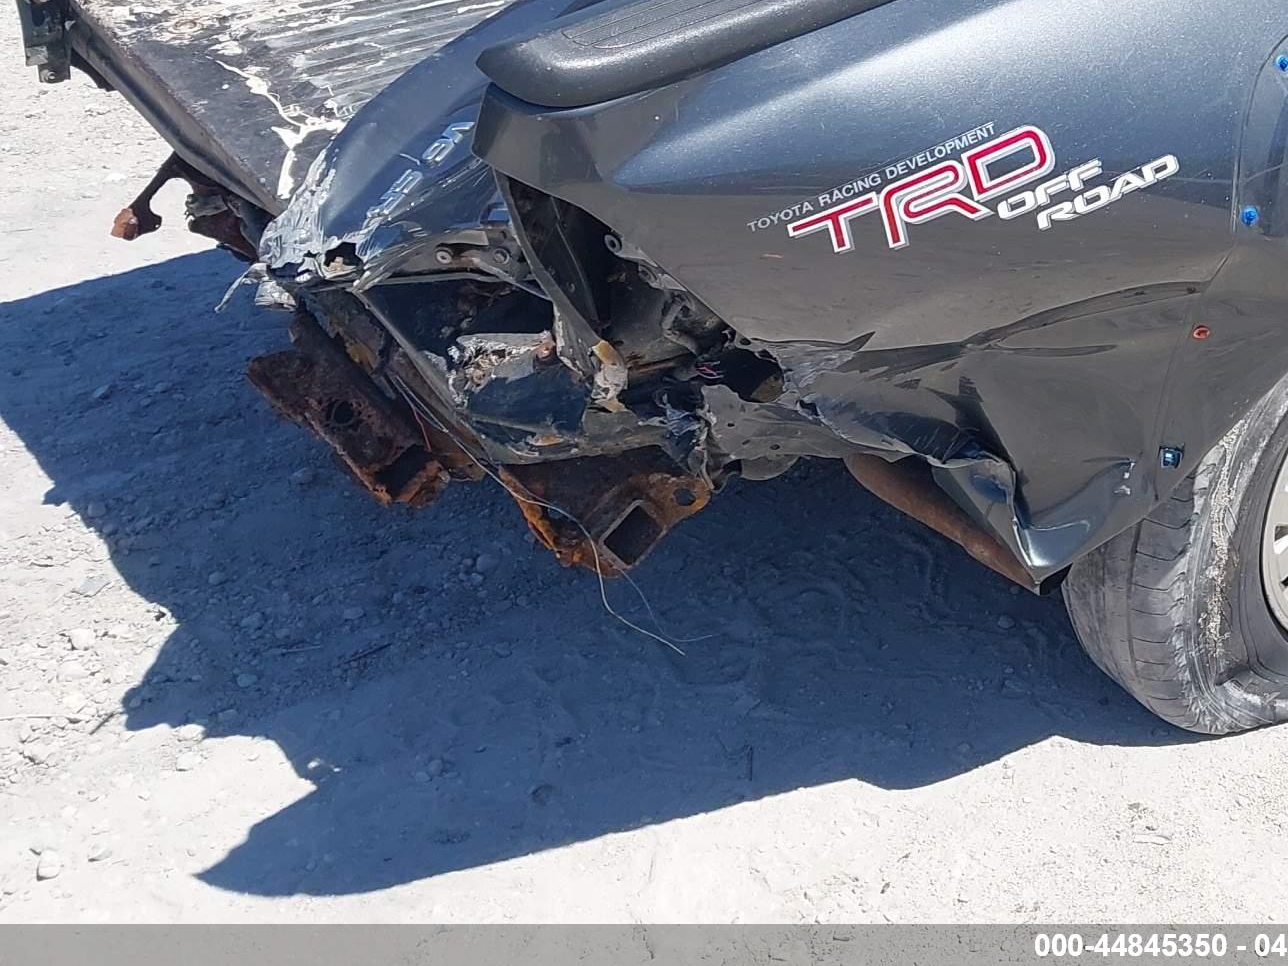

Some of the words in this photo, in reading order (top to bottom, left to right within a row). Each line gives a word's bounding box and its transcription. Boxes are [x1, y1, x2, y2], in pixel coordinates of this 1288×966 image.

[747, 200, 814, 232] TOYOTA
[818, 172, 882, 208] RACING
[885, 121, 996, 180] DEVELOPMENT
[786, 124, 1056, 254] TRD
[997, 158, 1103, 221] OFF
[1036, 153, 1180, 231] ROAD
